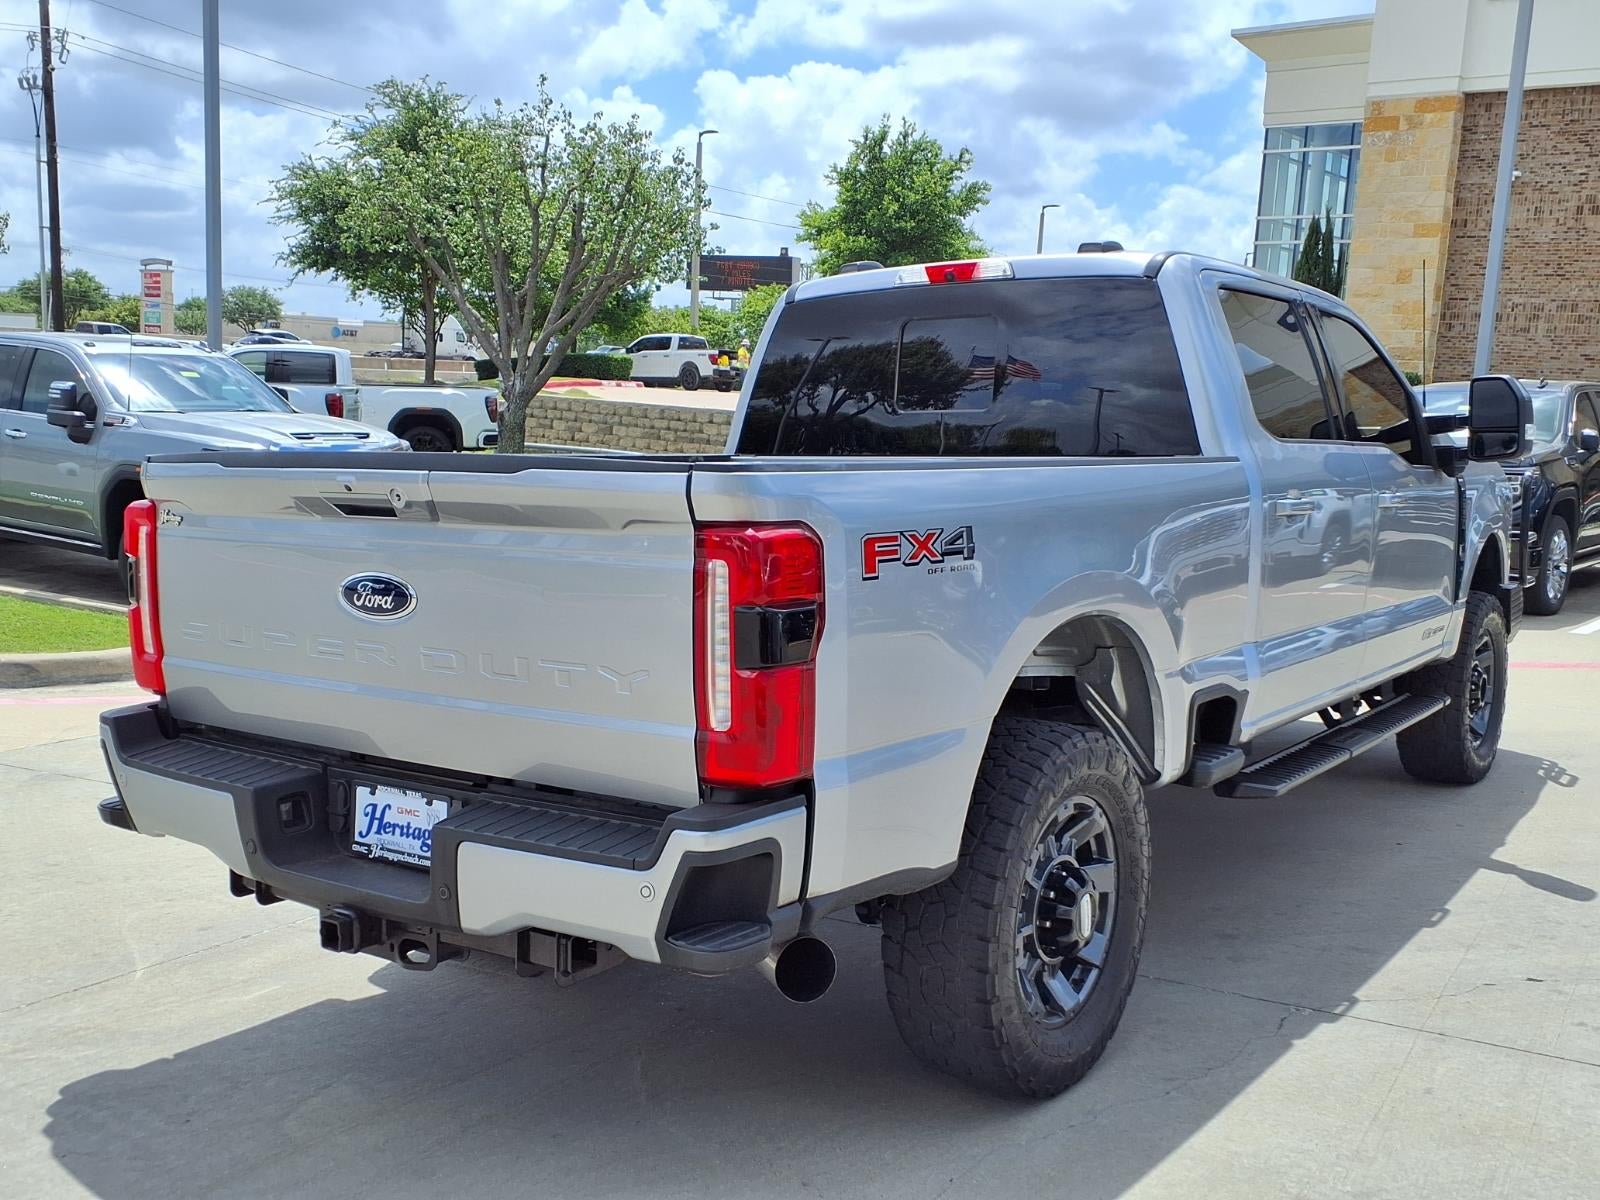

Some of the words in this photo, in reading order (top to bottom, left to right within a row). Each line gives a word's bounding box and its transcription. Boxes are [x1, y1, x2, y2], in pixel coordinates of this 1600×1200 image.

[341, 329, 359, 337] AT&T
[861, 525, 976, 581] FX4
[927, 566, 947, 576] OFF
[950, 563, 976, 573] ROAD
[353, 581, 396, 610] Ford
[180, 620, 399, 668] SUPER
[418, 644, 651, 696] DUTY
[396, 806, 421, 818] GMC
[358, 803, 432, 853] Heritag
